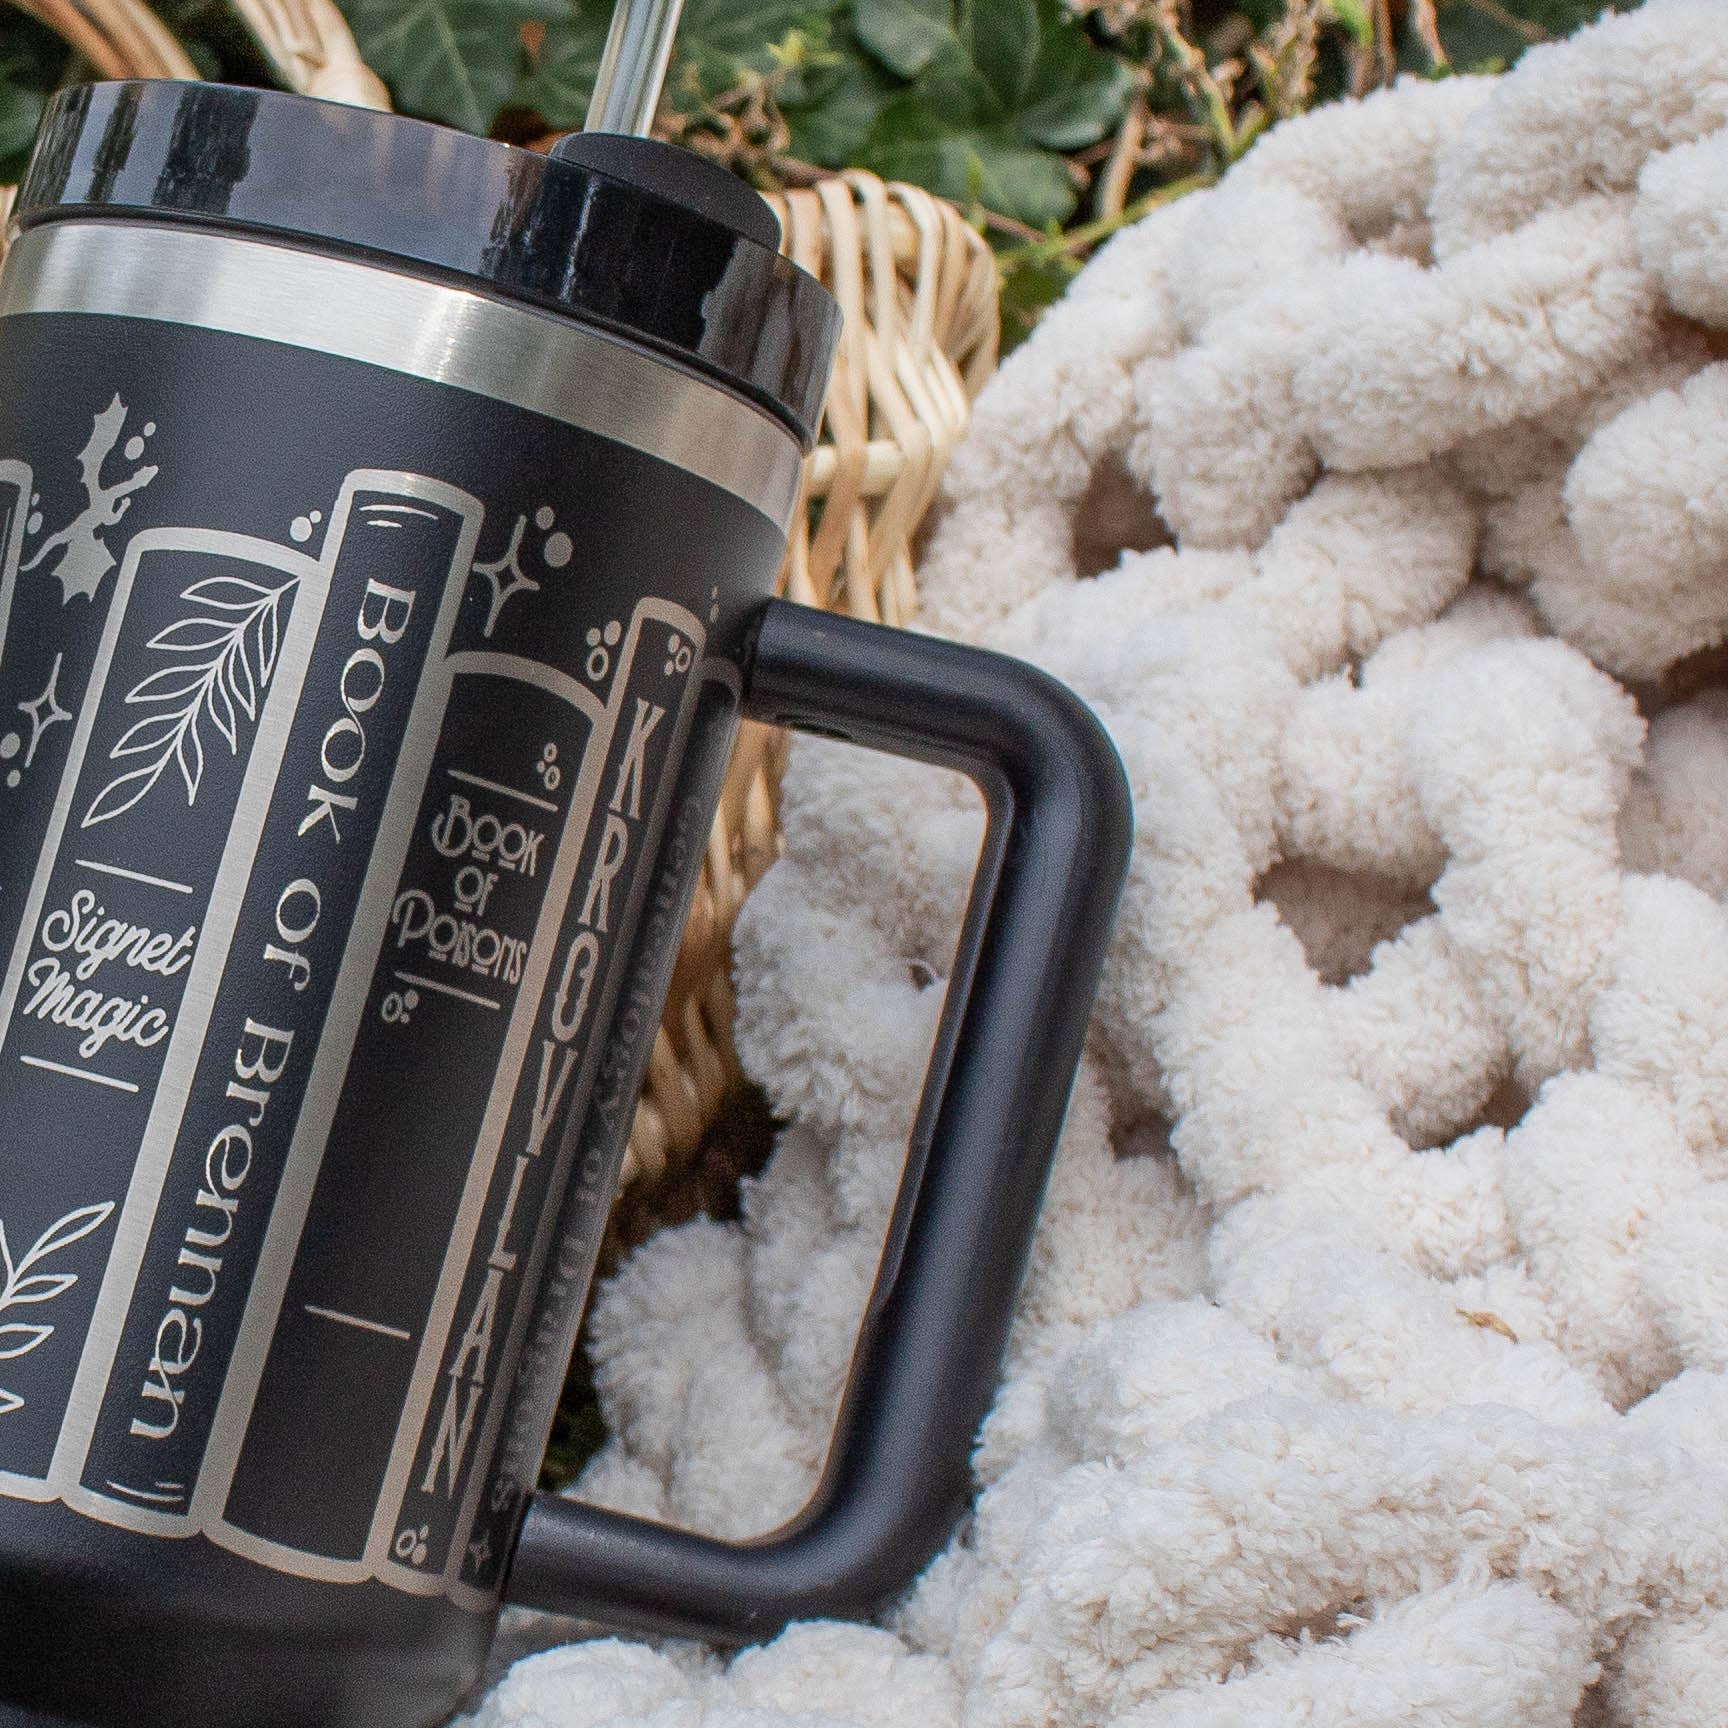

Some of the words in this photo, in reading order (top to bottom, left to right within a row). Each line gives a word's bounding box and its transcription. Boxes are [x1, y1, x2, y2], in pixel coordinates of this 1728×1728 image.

[297, 576, 415, 843] Book
[23, 956, 170, 1059] Magic
[41, 888, 197, 981] Signet
[129, 1016, 295, 1441] Brennan
[421, 698, 666, 1499] KROVLAN
